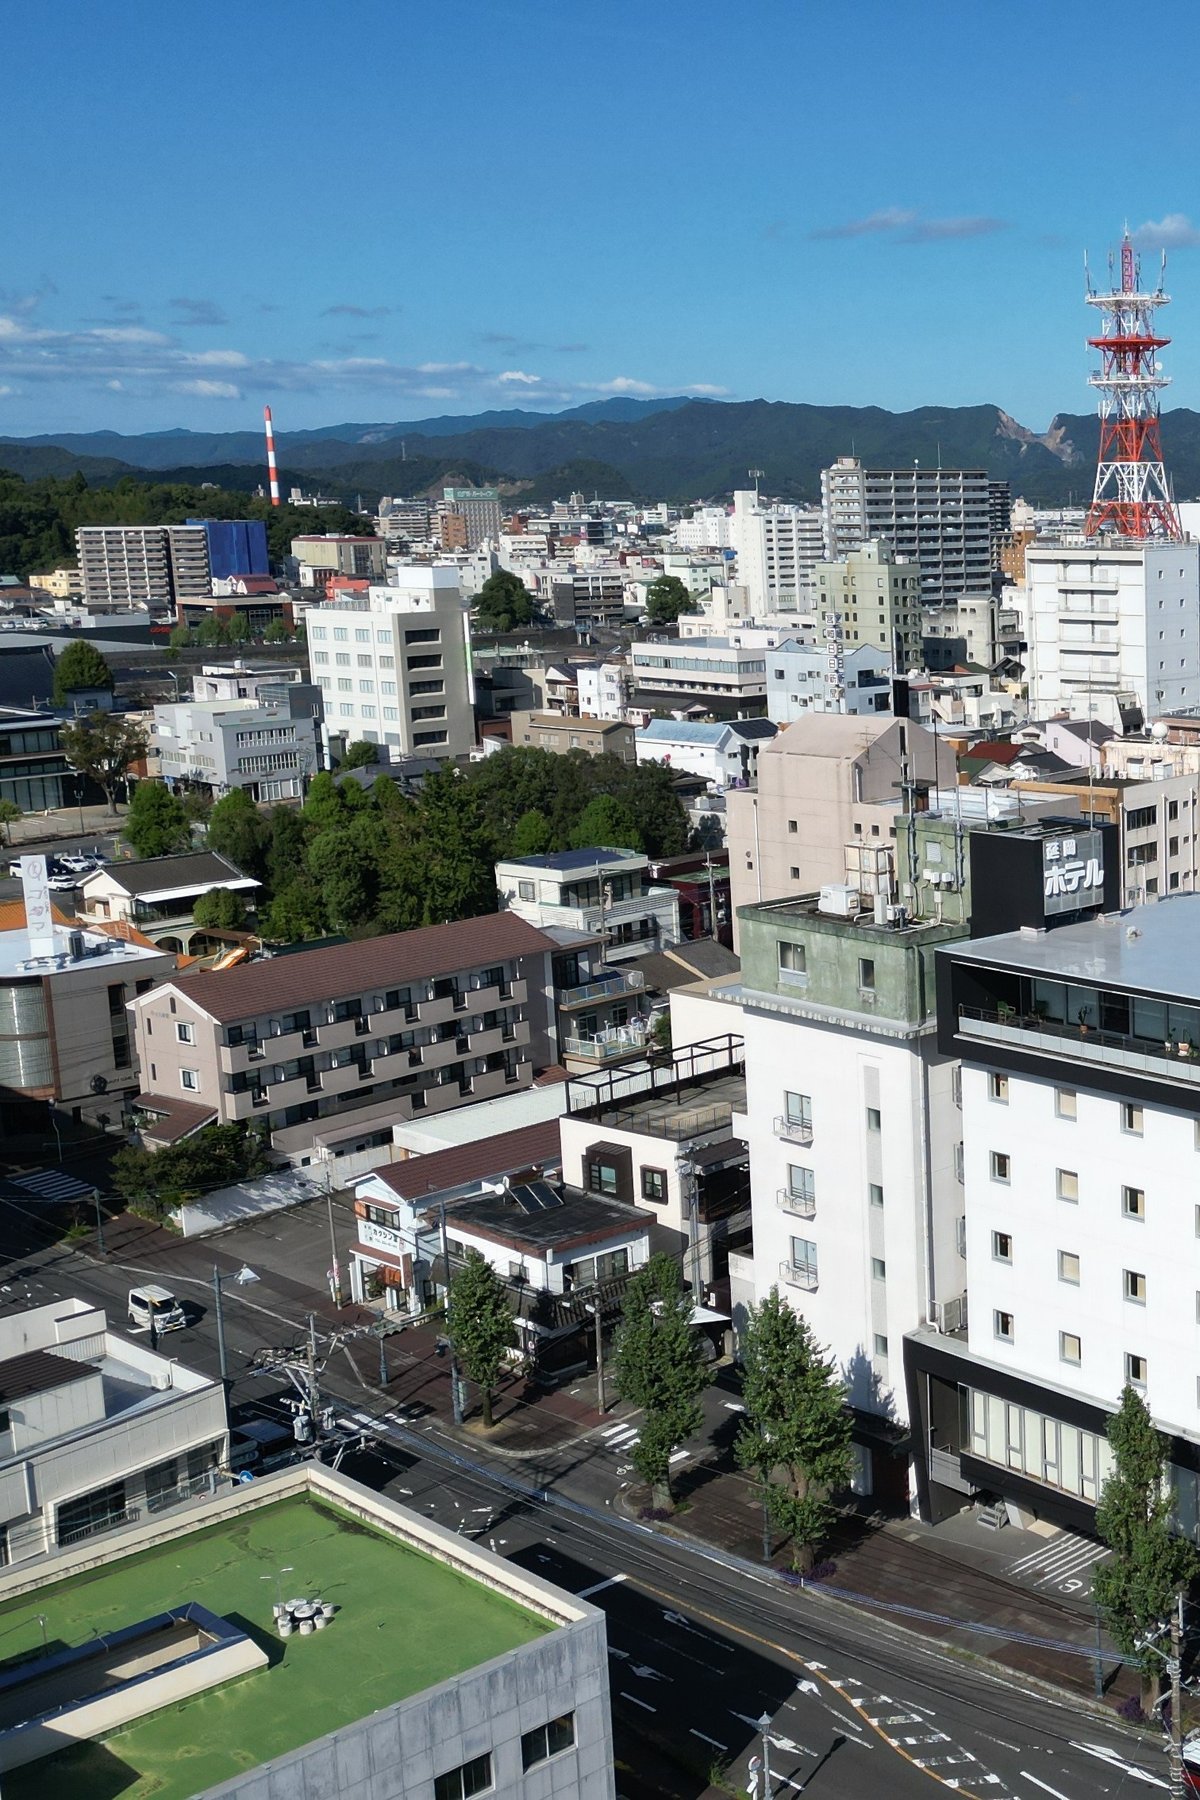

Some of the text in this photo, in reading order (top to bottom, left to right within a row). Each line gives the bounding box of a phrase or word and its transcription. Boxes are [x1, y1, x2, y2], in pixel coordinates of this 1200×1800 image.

[1046, 839, 1076, 860] 延岡
[1045, 858, 1104, 896] ホテル
